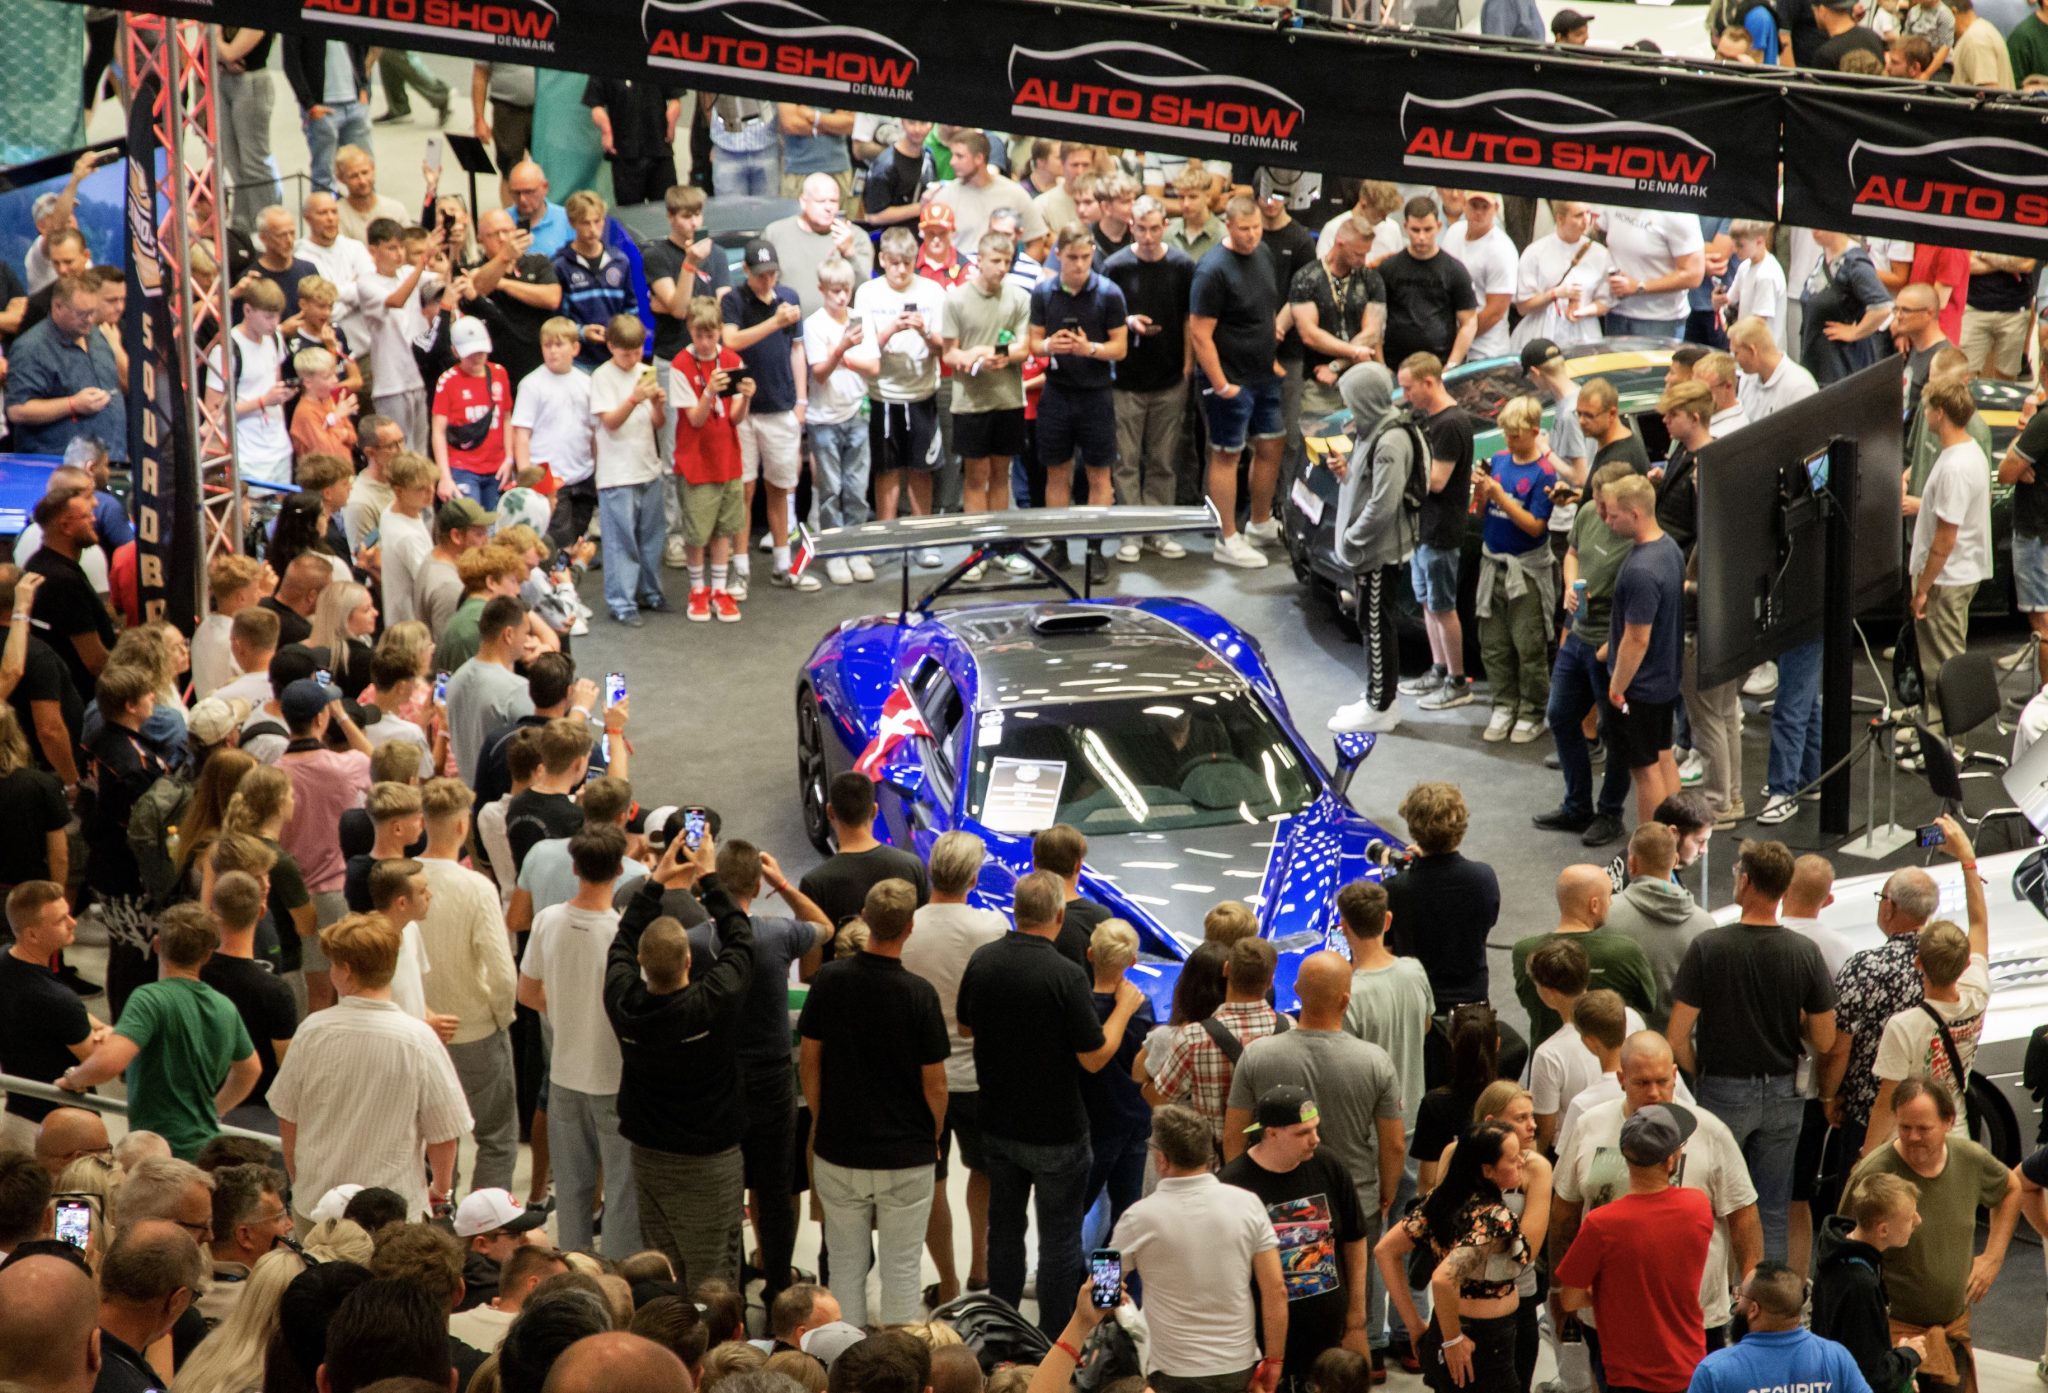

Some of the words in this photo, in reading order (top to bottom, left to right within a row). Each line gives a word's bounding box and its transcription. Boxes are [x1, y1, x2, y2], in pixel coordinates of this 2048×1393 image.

[424, 0, 553, 39] SHOW
[496, 35, 556, 53] DENMARK
[650, 29, 768, 69] AUTO
[775, 45, 913, 88] SHOW
[851, 82, 914, 101] DENMARK
[1014, 77, 1142, 120] AUTO
[1150, 95, 1299, 139] SHOW
[1232, 132, 1299, 152] DENMARK
[1406, 126, 1542, 166] AUTO
[1551, 141, 1710, 184] SHOW
[1637, 179, 1709, 199] DENMARK
[1855, 174, 2005, 220] AUTO
[2014, 193, 2048, 226] S
